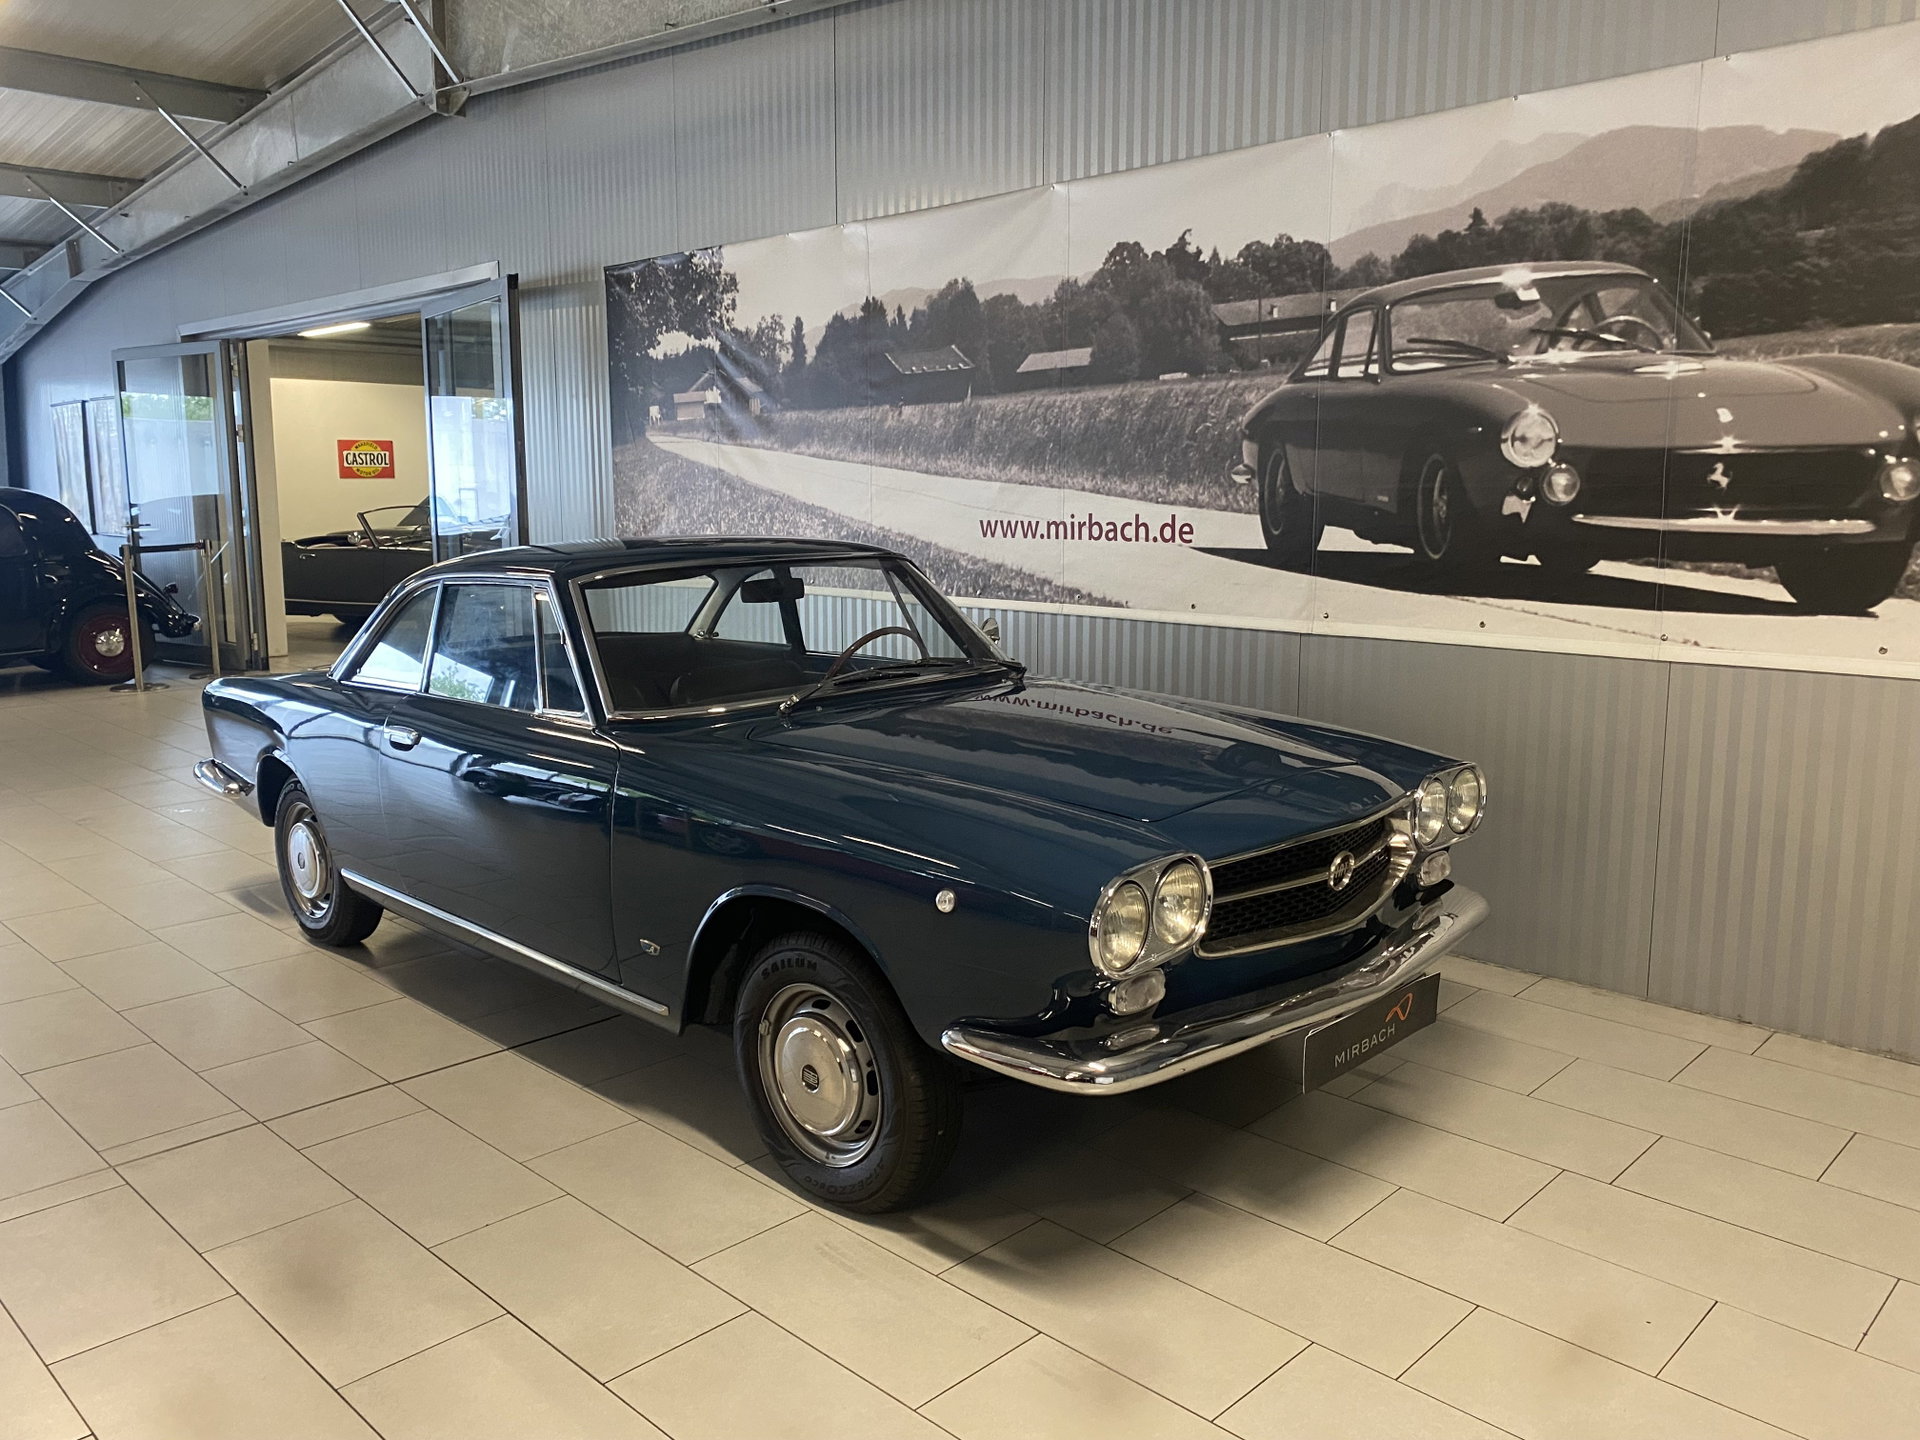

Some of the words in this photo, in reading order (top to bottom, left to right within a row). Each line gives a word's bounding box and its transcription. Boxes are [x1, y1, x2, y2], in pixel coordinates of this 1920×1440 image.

[345, 452, 389, 466] CASTROL
[979, 513, 1195, 544] www.mirbach.de
[761, 957, 817, 980] SAILUN
[1334, 1023, 1396, 1068] MIRBACH
